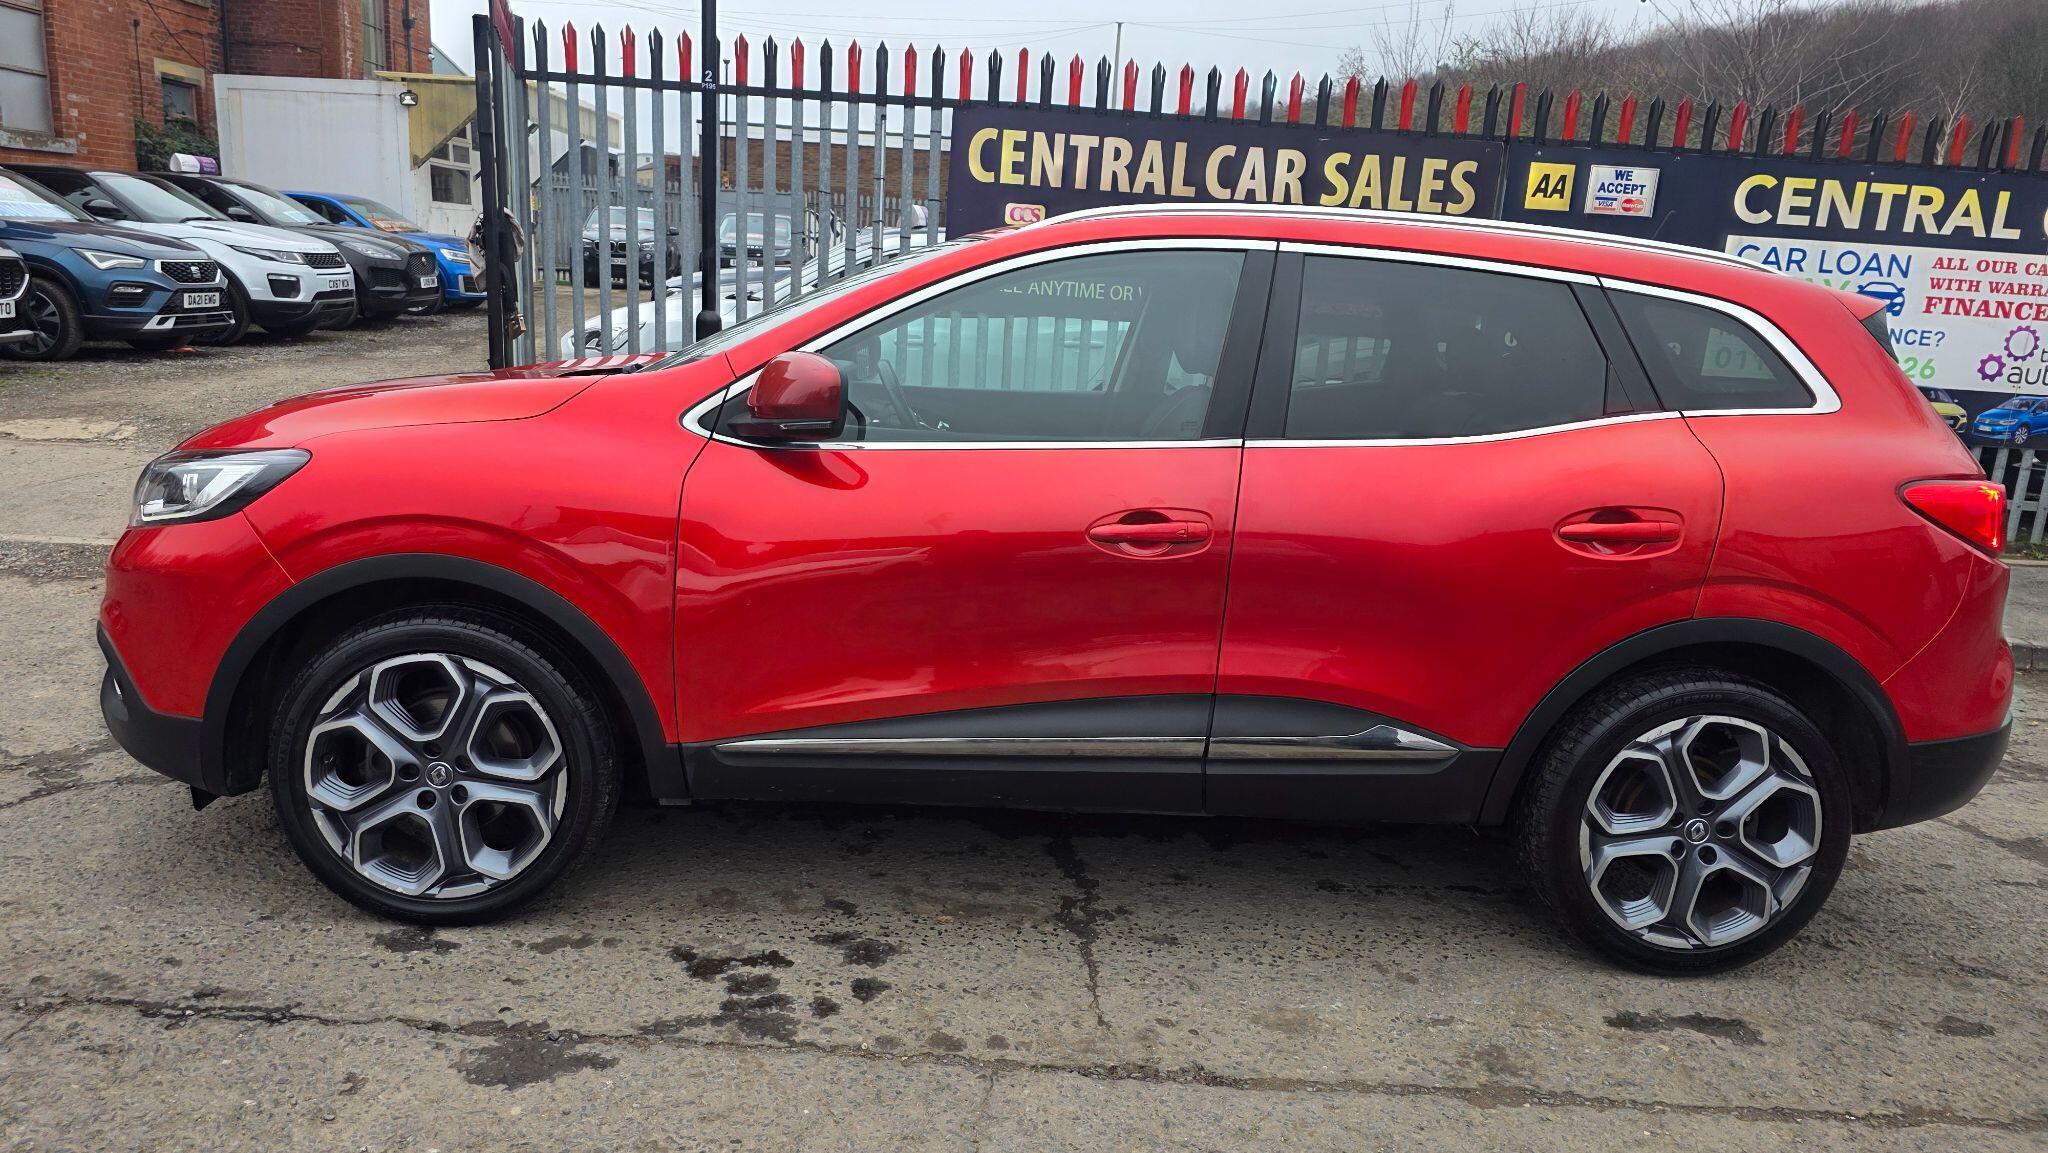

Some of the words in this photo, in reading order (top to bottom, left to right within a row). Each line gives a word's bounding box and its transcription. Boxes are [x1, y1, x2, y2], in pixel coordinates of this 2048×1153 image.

[704, 70, 713, 82] 2
[968, 127, 1196, 198] CENTRAL
[1205, 144, 1304, 205] CAR
[1319, 152, 1479, 215] SALES
[1614, 169, 1634, 182] WE
[1531, 173, 1568, 199] AA
[1597, 182, 1647, 196] ACCEPT
[1598, 200, 1614, 208] VISA
[1734, 174, 2021, 240] CENTRAL
[1818, 249, 1913, 279] LOAN
[1931, 256, 1969, 271] ALL
[1975, 259, 2018, 275] OUR
[1027, 280, 1105, 300] ANYTIME
[1109, 285, 1134, 301] OR
[1929, 277, 1982, 293] WITH
[1922, 295, 2048, 322] FINANCE
